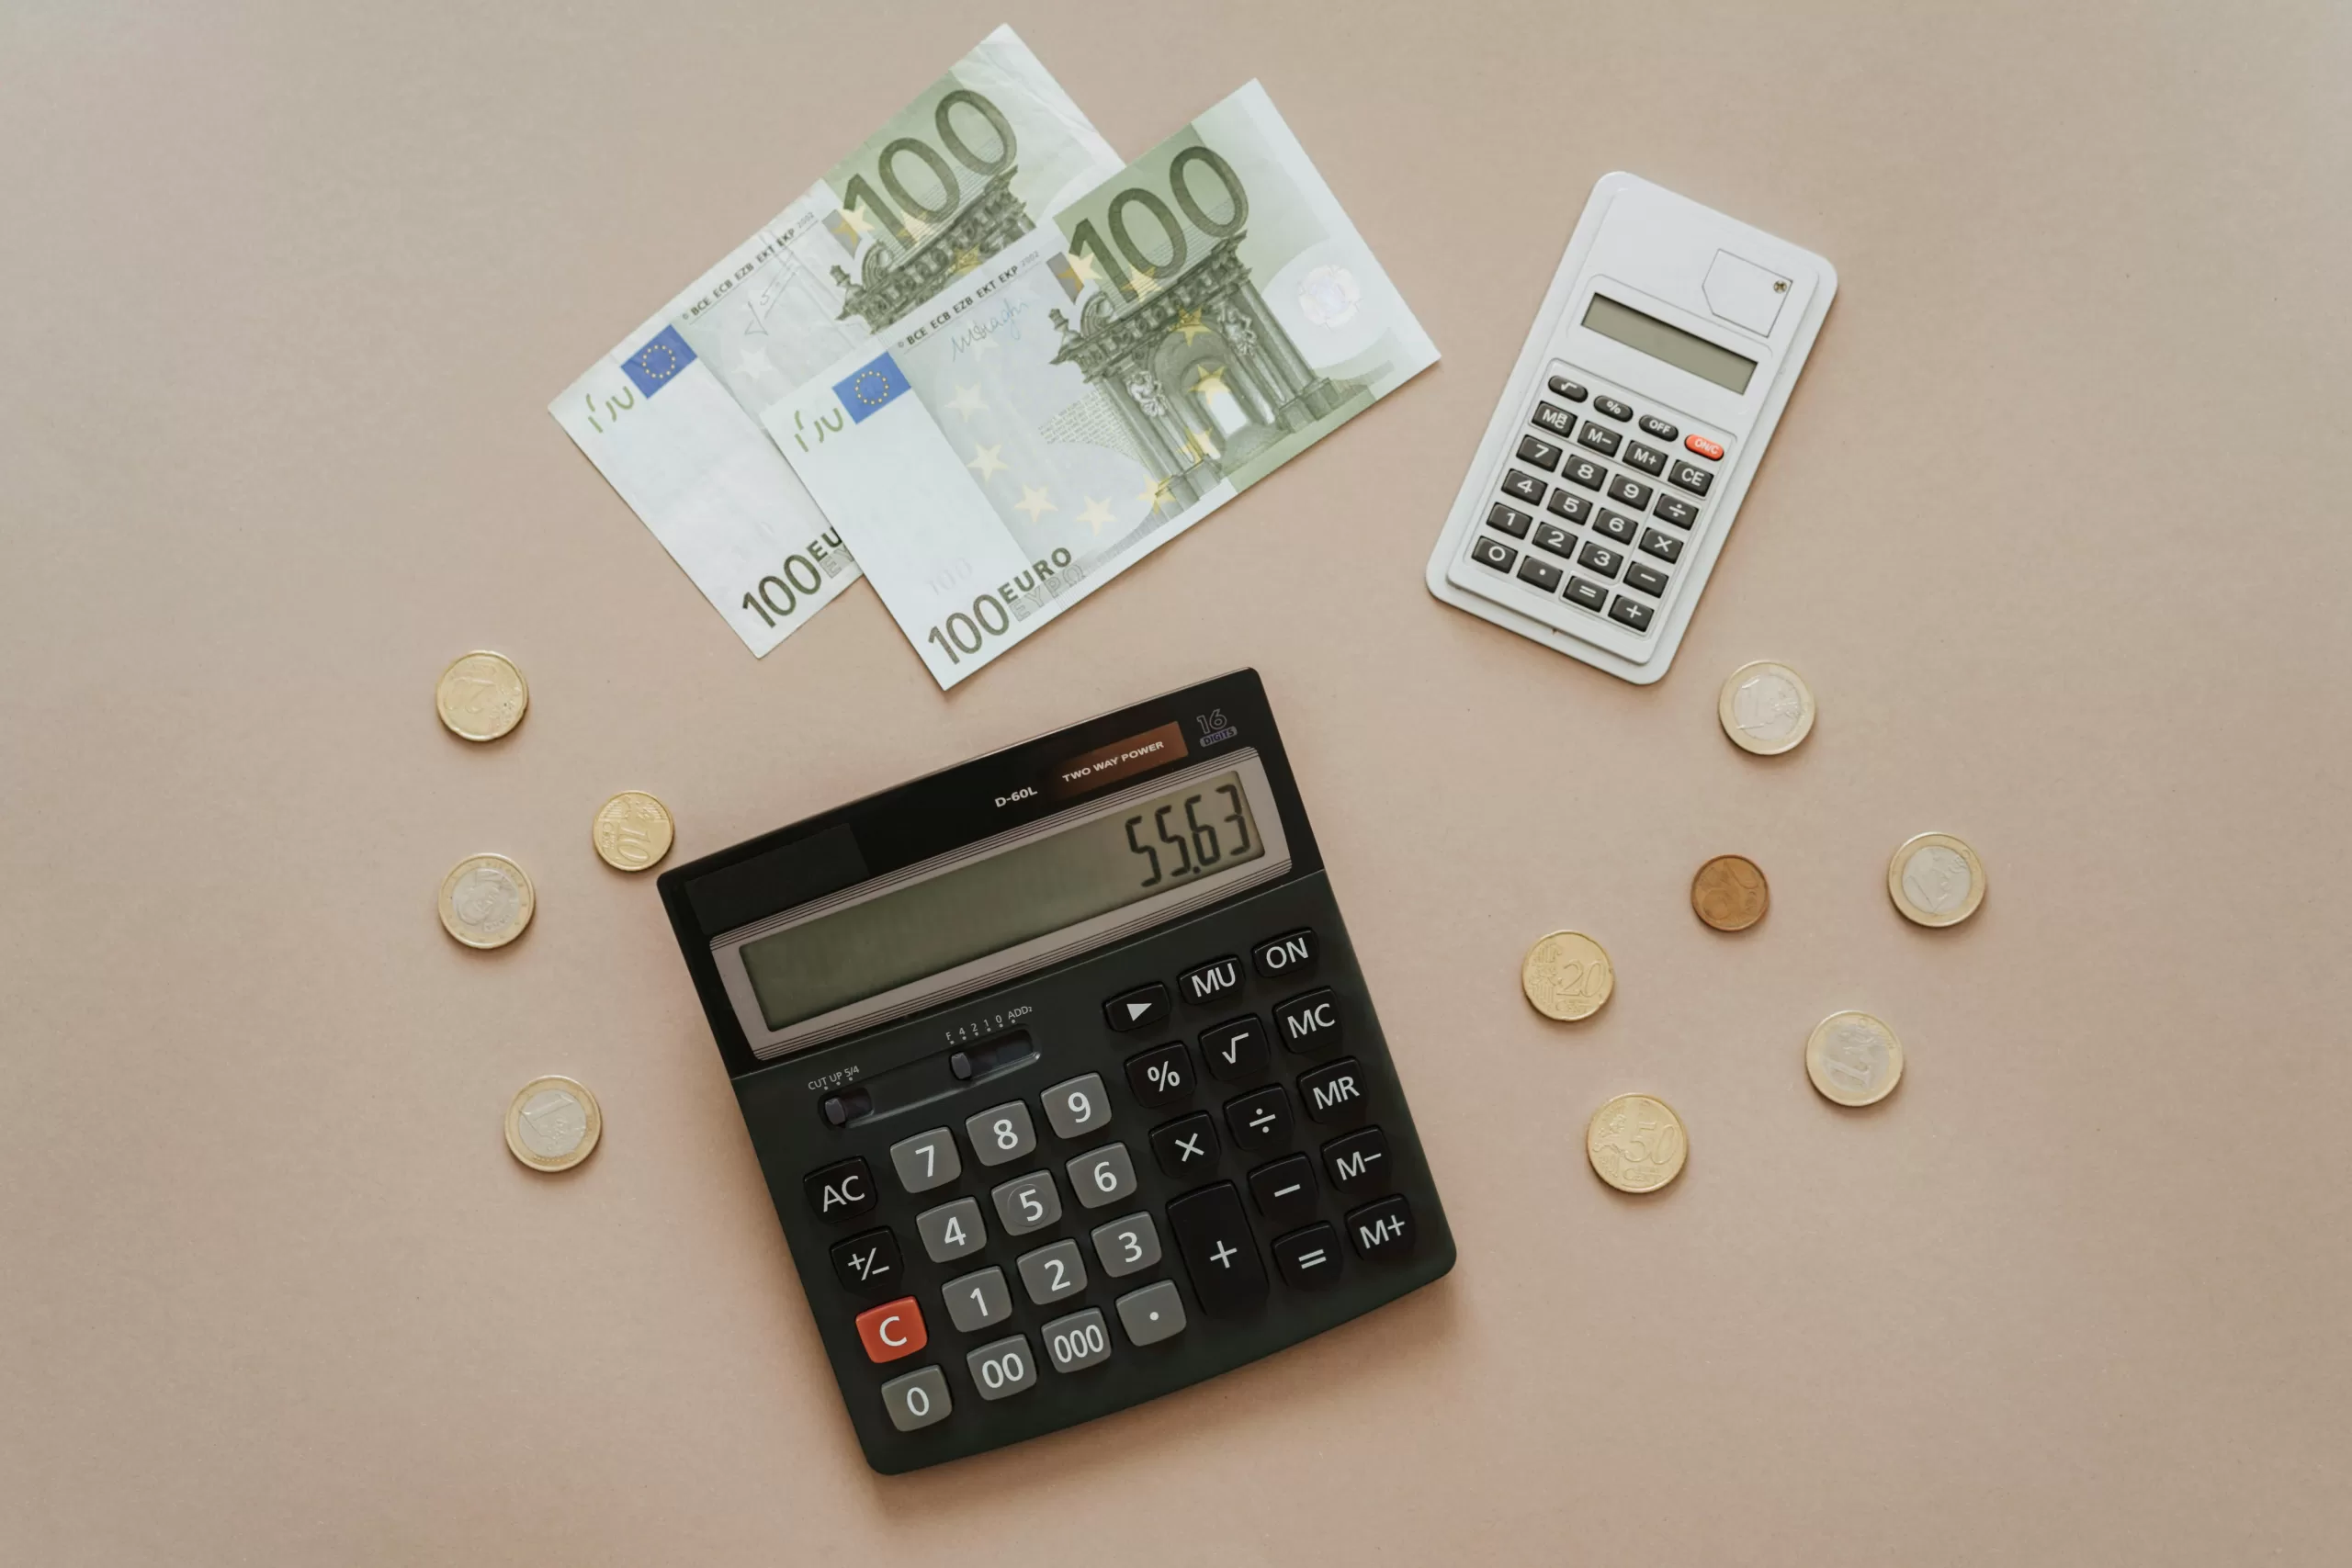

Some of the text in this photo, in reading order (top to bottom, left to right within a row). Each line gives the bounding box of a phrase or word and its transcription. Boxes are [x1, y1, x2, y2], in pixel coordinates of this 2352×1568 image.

[843, 88, 1017, 250] 100
[1069, 146, 1249, 303] 100
[691, 297, 711, 316] BCE
[712, 278, 733, 299] ECB
[734, 263, 754, 281] EZB
[755, 244, 775, 264] EKT
[776, 228, 796, 247] EKP
[907, 326, 928, 345] BCE
[930, 311, 951, 330] ECB
[953, 296, 973, 314] EZB
[976, 280, 997, 299] EKT
[998, 265, 1019, 283] EKP
[1648, 419, 1671, 434] OFF
[1535, 444, 1549, 458] 7
[1694, 439, 1719, 455] ON/C
[1517, 479, 1532, 493] 4
[1577, 464, 1593, 479] 8
[1681, 468, 1704, 487] CE
[1563, 497, 1578, 513] 5
[1623, 483, 1640, 499] 9
[1507, 512, 1514, 526] 1
[1609, 517, 1625, 533] 6
[1488, 546, 1506, 561] 0
[1548, 531, 1565, 547] 2
[1594, 549, 1611, 567] 3
[742, 554, 822, 628] 100
[928, 547, 1072, 665] 100 EURO
[1196, 708, 1227, 735] 16
[1203, 728, 1236, 747] DIGITS
[1062, 740, 1165, 783] TWO WAY POWER
[994, 785, 1038, 808] D-60L
[1125, 784, 1250, 887] 55.63
[1266, 937, 1309, 969] ON
[1191, 963, 1237, 998] MU
[1555, 959, 1606, 998] 20
[945, 1031, 952, 1041] F
[958, 1027, 966, 1035] 4
[971, 1022, 978, 1032] 2
[983, 1019, 989, 1027] 1
[995, 1014, 1002, 1023] 0
[1287, 1003, 1335, 1039] MC
[808, 1065, 860, 1090] CUT UP 5/4
[1312, 1076, 1360, 1110] MR
[1068, 1091, 1091, 1122] 9
[993, 1119, 1019, 1150] 8
[1623, 1122, 1679, 1165] 50
[915, 1145, 935, 1178] 7
[1093, 1161, 1118, 1192] 6
[822, 1175, 865, 1213] AC
[1019, 1189, 1044, 1222] 5
[944, 1216, 967, 1247] 4
[1117, 1231, 1143, 1262] 3
[1359, 1214, 1405, 1248] M+
[1044, 1259, 1071, 1292] 2
[969, 1287, 989, 1317] 1
[878, 1315, 908, 1347] C
[1054, 1324, 1103, 1363] 000
[981, 1353, 1024, 1388] 00
[906, 1386, 930, 1416] 0
